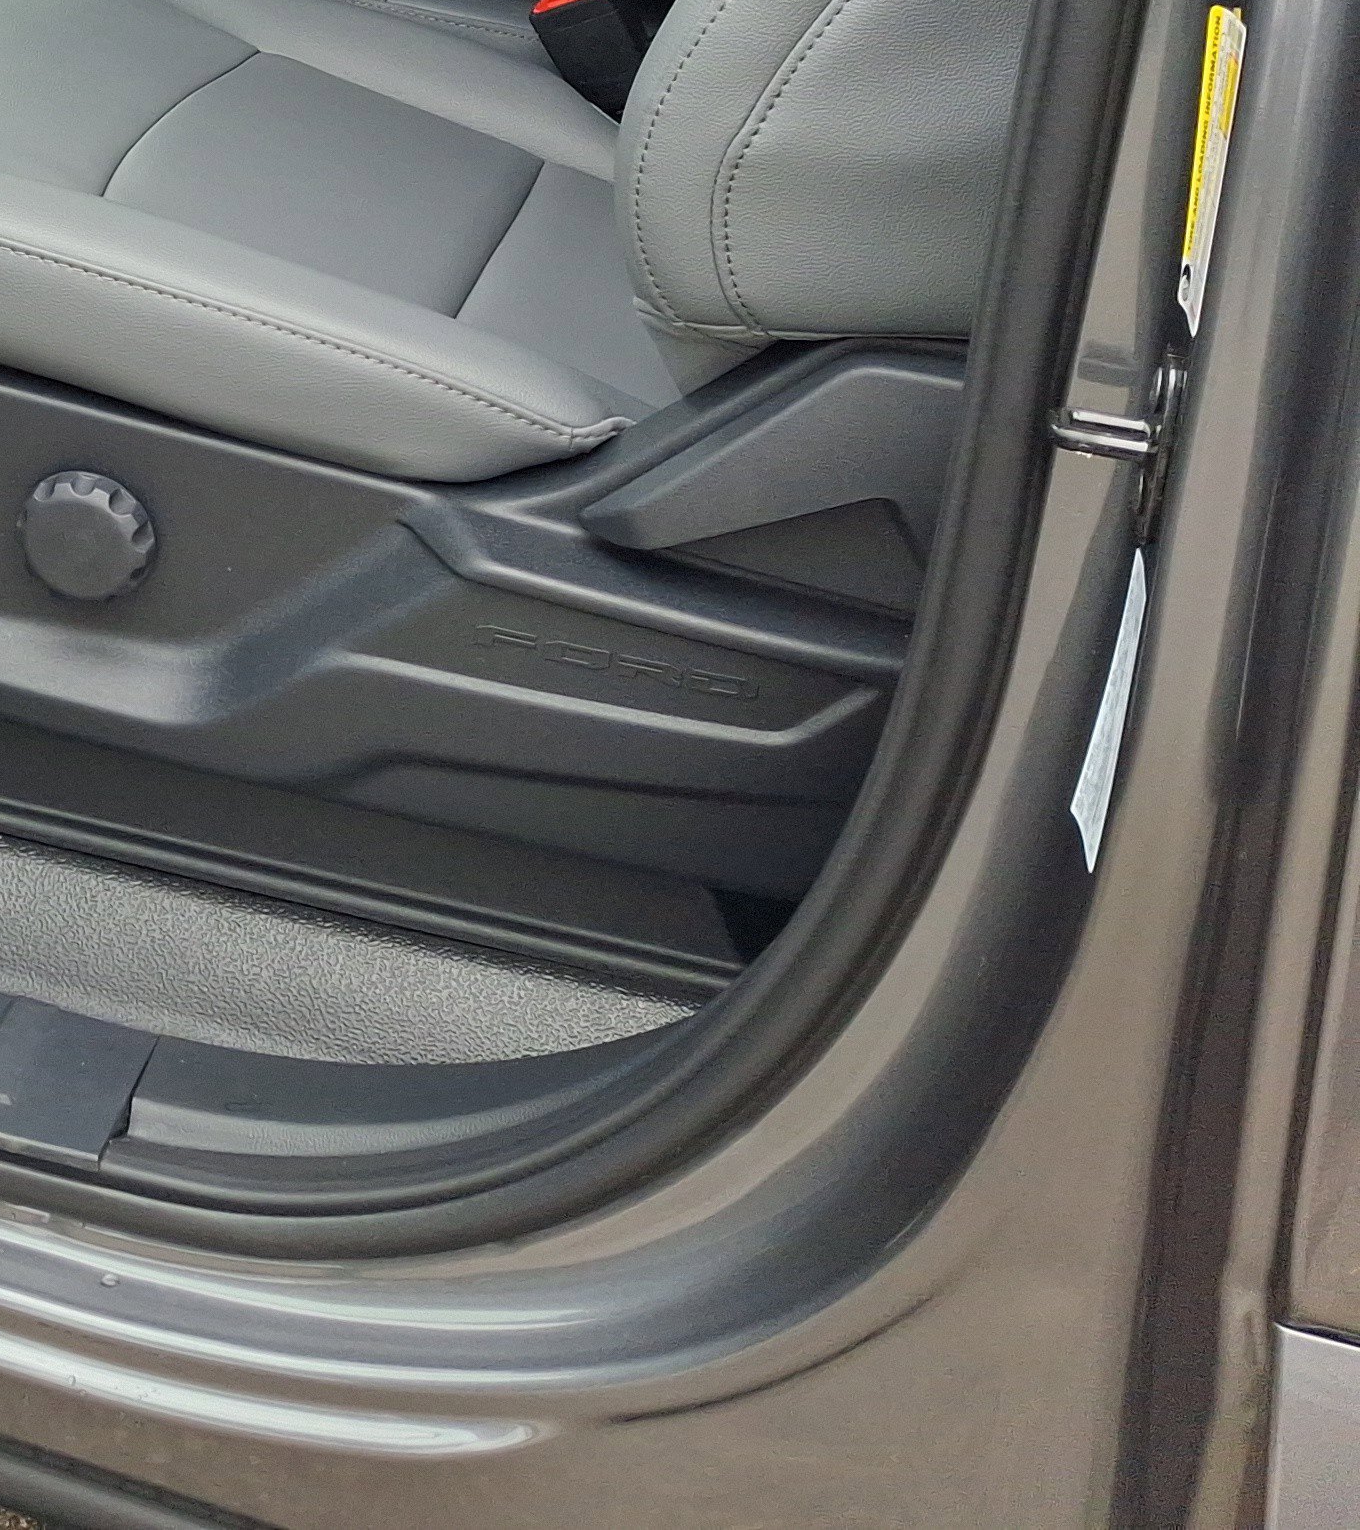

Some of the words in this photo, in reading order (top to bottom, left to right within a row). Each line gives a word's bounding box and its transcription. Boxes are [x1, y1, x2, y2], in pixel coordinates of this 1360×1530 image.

[1197, 120, 1210, 184] LOADING
[1205, 15, 1220, 117] INFORMATION
[471, 624, 760, 700] FORD
